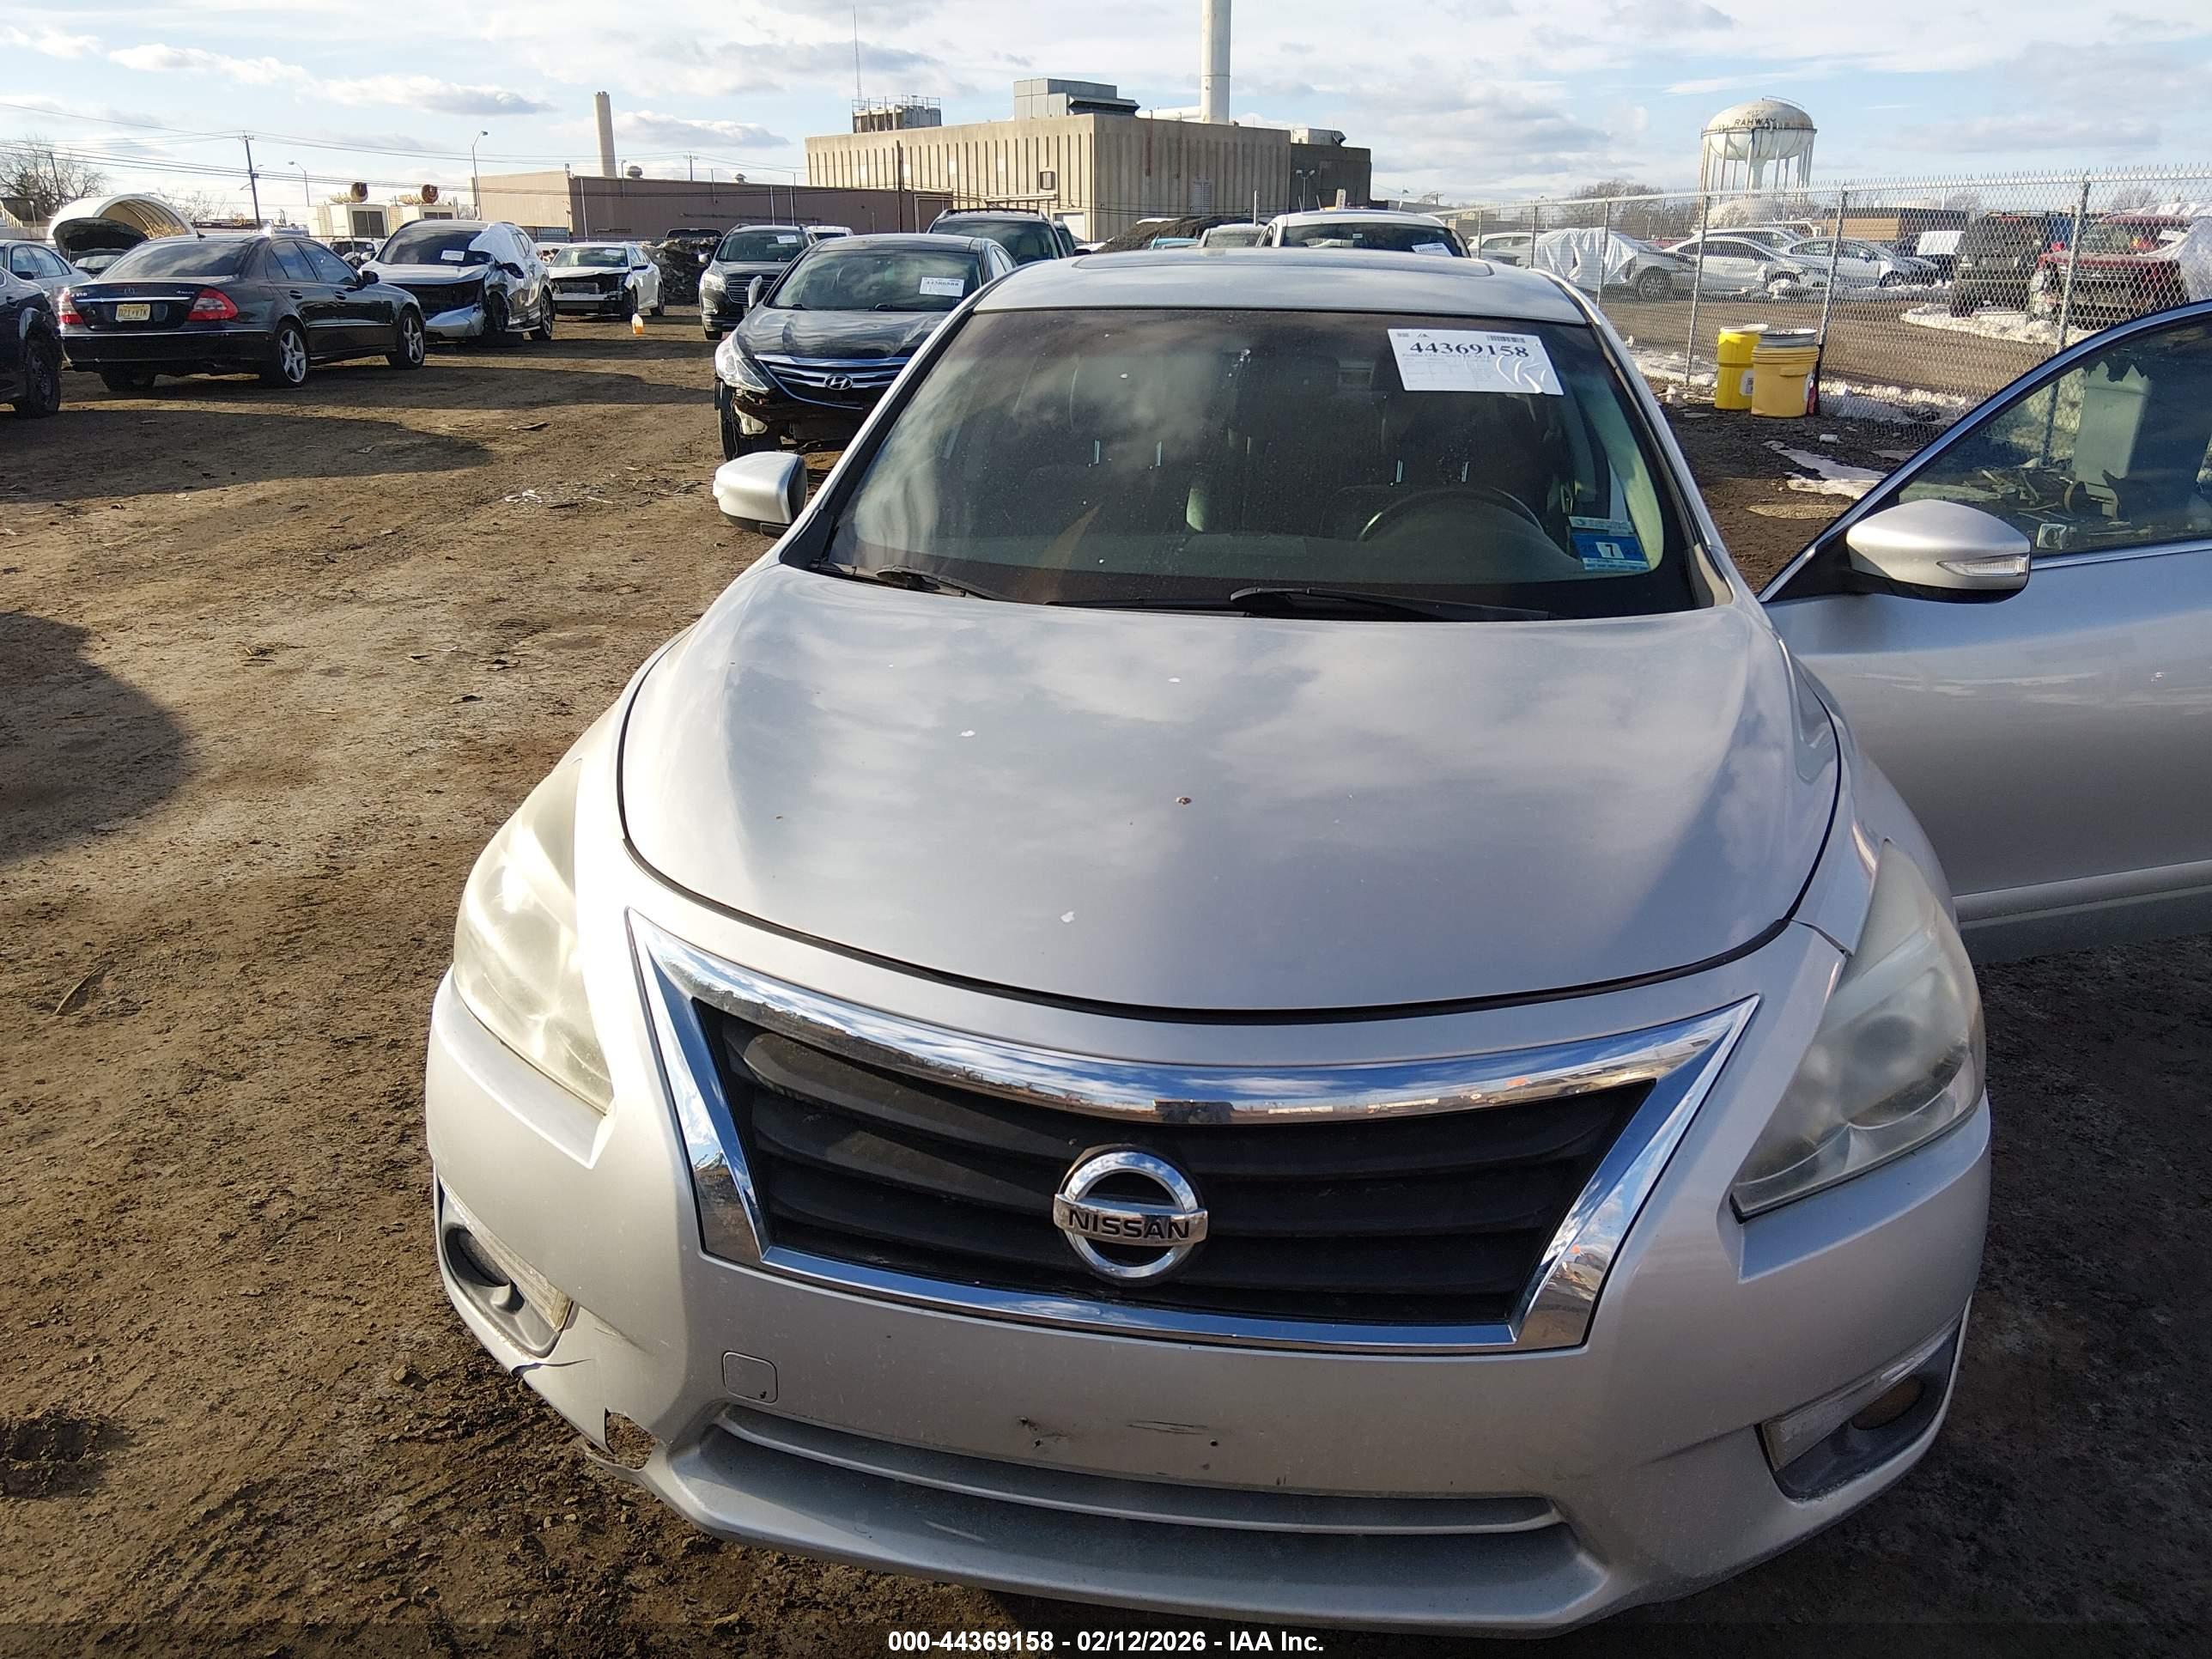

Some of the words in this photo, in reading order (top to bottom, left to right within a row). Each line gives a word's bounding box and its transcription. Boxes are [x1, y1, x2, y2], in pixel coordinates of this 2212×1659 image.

[1735, 118, 1777, 126] RAHWAY
[1410, 342, 1529, 358] 44369158
[1605, 544, 1615, 557] 7
[1068, 1209, 1189, 1239] NISSAN
